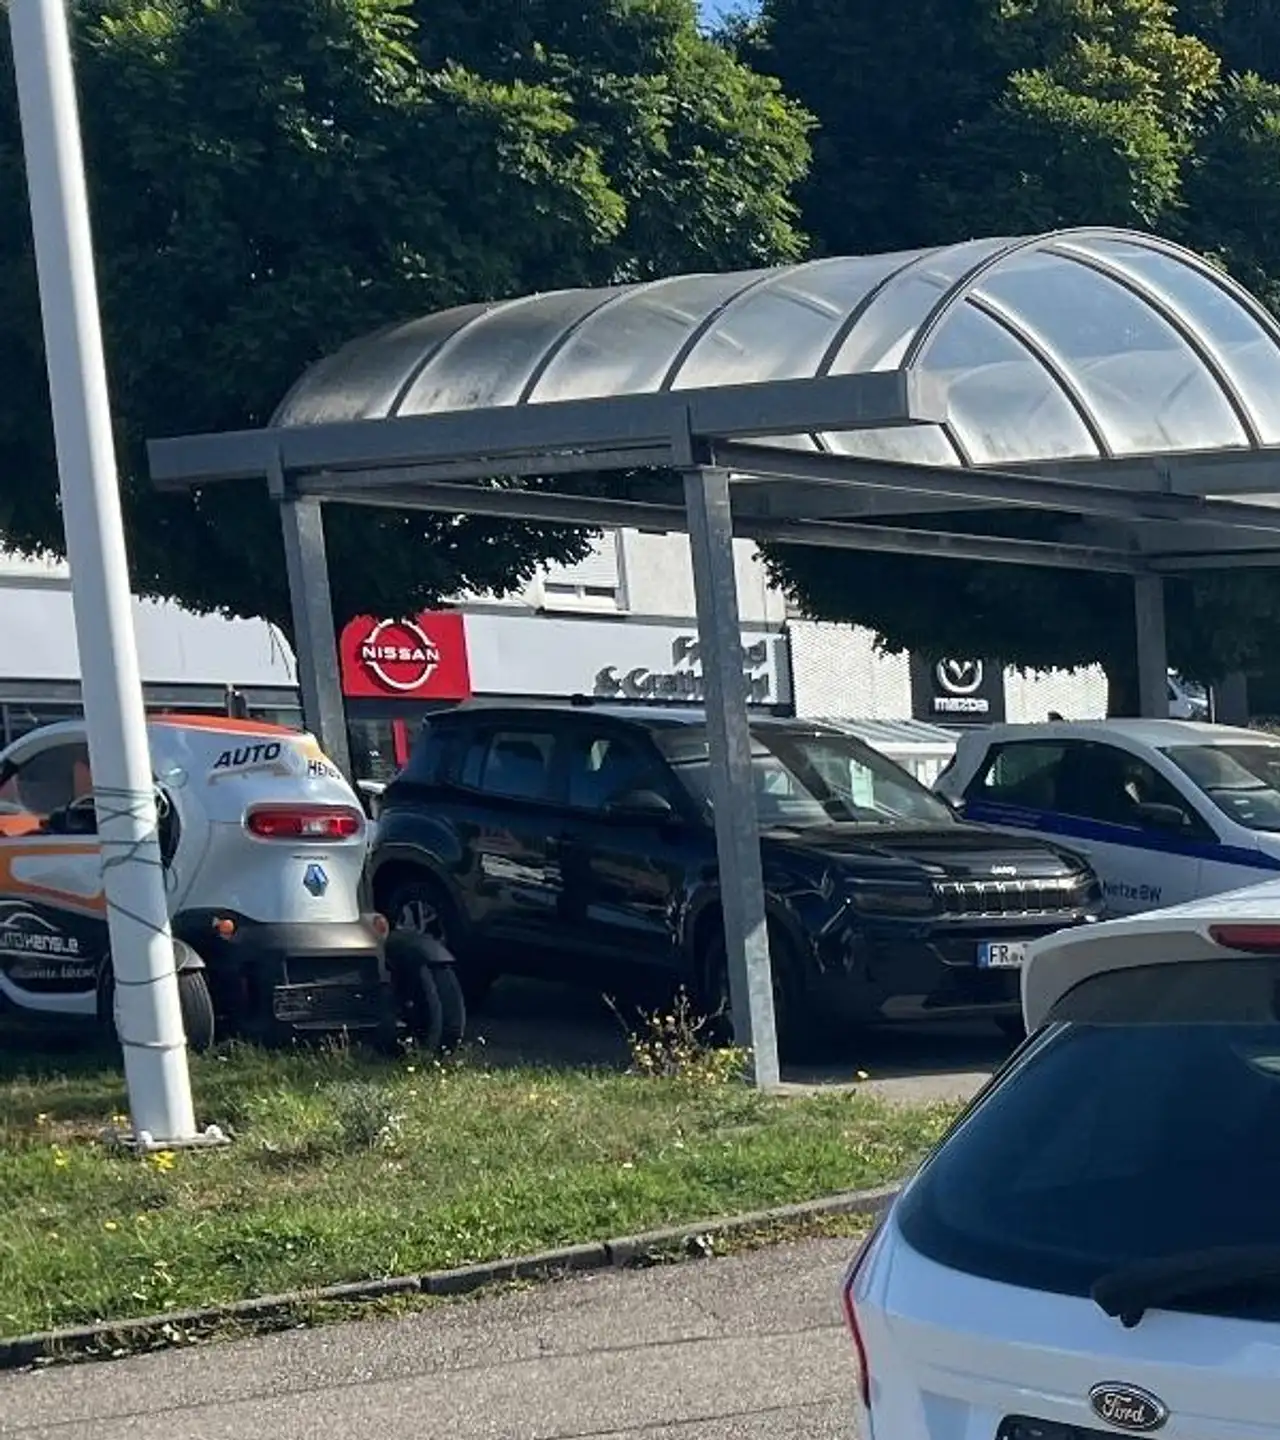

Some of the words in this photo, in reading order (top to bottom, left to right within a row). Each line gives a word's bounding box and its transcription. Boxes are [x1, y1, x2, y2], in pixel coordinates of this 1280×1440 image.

[362, 646, 440, 661] NISSAN
[934, 697, 989, 712] mazda
[214, 742, 281, 769] AUTO
[989, 945, 1009, 963] FR
[1102, 1392, 1146, 1423] Ford
